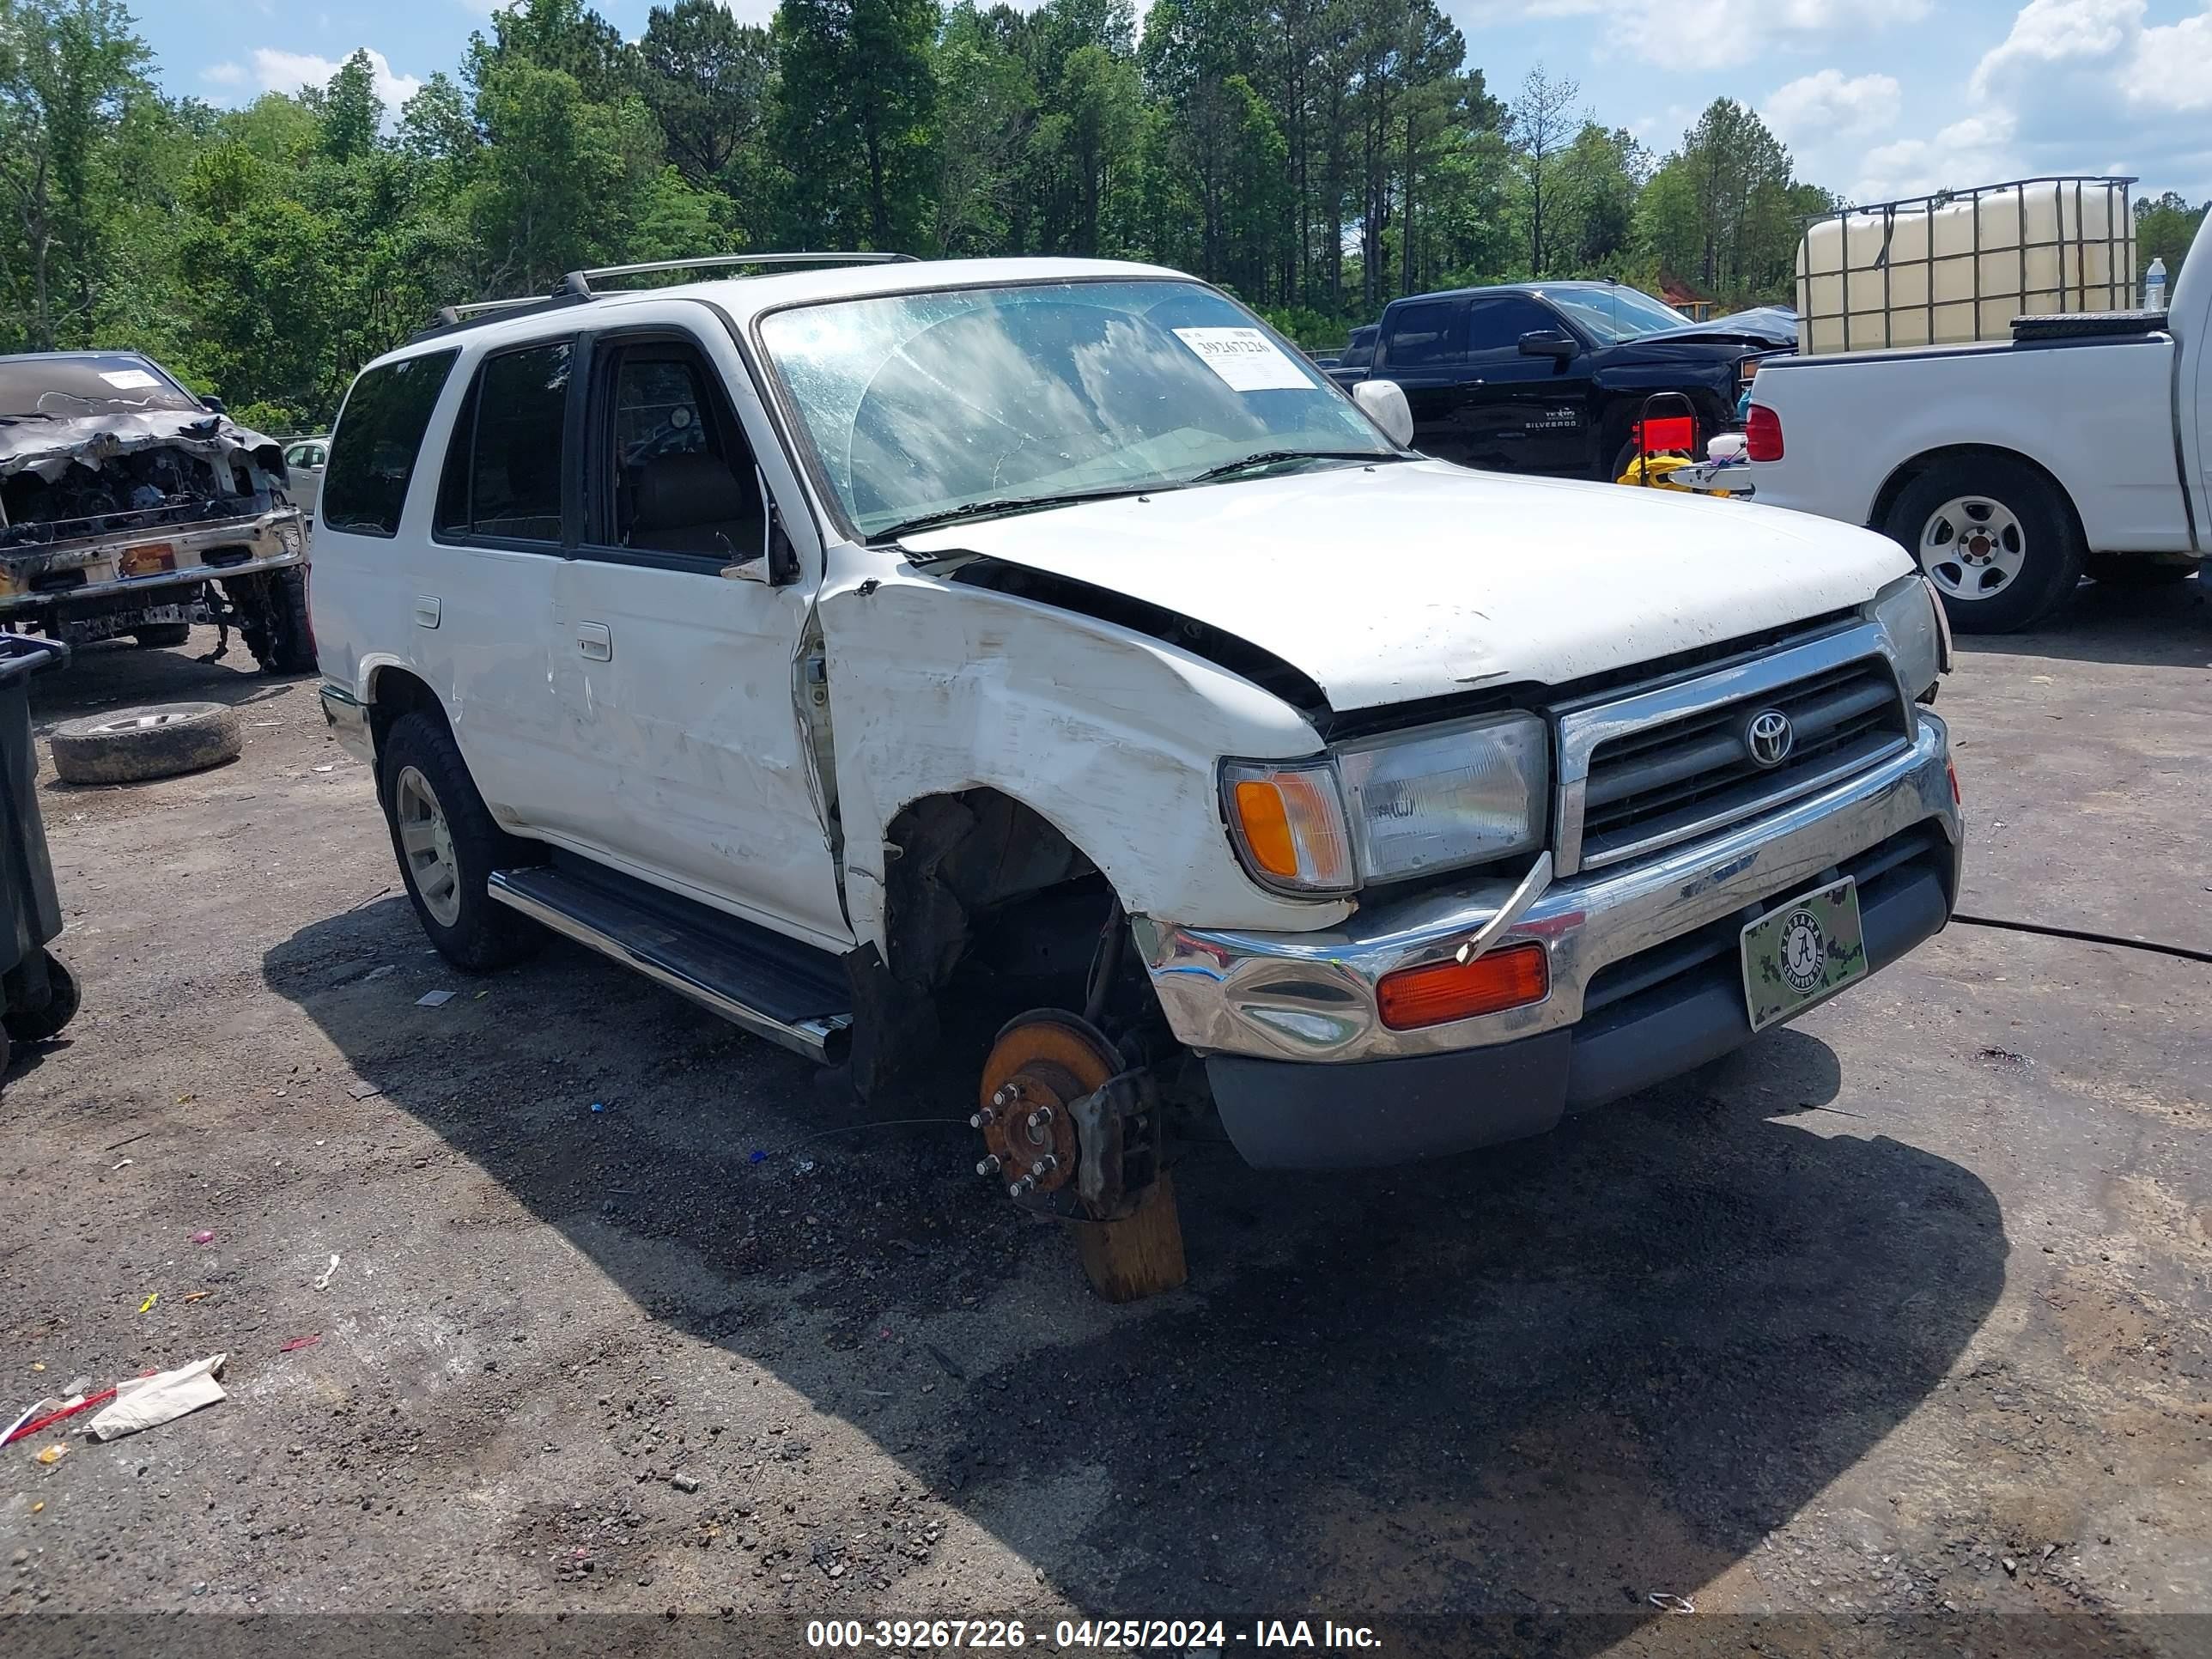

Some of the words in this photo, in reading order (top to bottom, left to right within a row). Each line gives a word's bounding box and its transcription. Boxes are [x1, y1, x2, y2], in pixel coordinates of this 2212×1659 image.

[1198, 342, 1270, 354] 39267226
[1781, 915, 1820, 953] ALABAMA
[1793, 933, 1813, 969] A
[1784, 963, 1814, 988] CRIMSON
